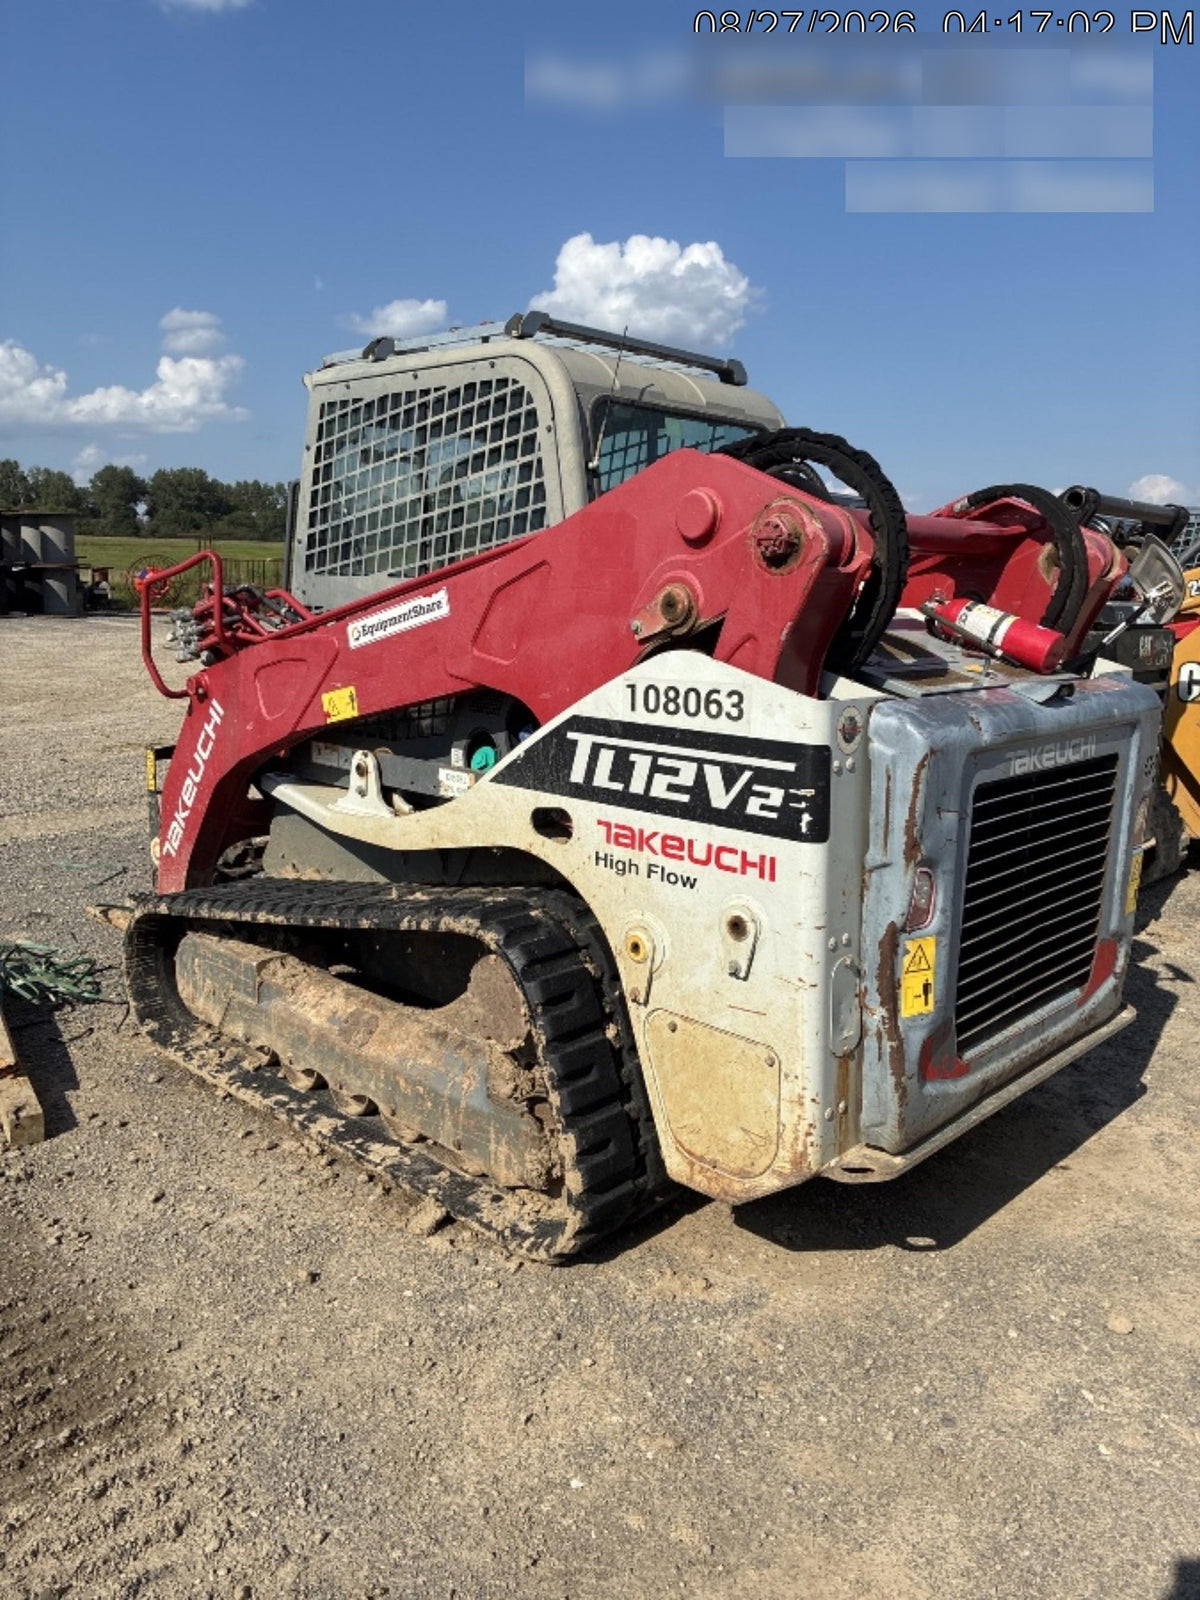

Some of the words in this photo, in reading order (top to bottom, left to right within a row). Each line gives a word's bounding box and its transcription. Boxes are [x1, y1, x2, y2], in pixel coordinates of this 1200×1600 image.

[360, 600, 443, 637] EquipmentShare
[626, 683, 745, 722] 108063
[566, 731, 797, 819] TL12V2
[594, 850, 640, 877] High
[646, 863, 698, 890] Flow
